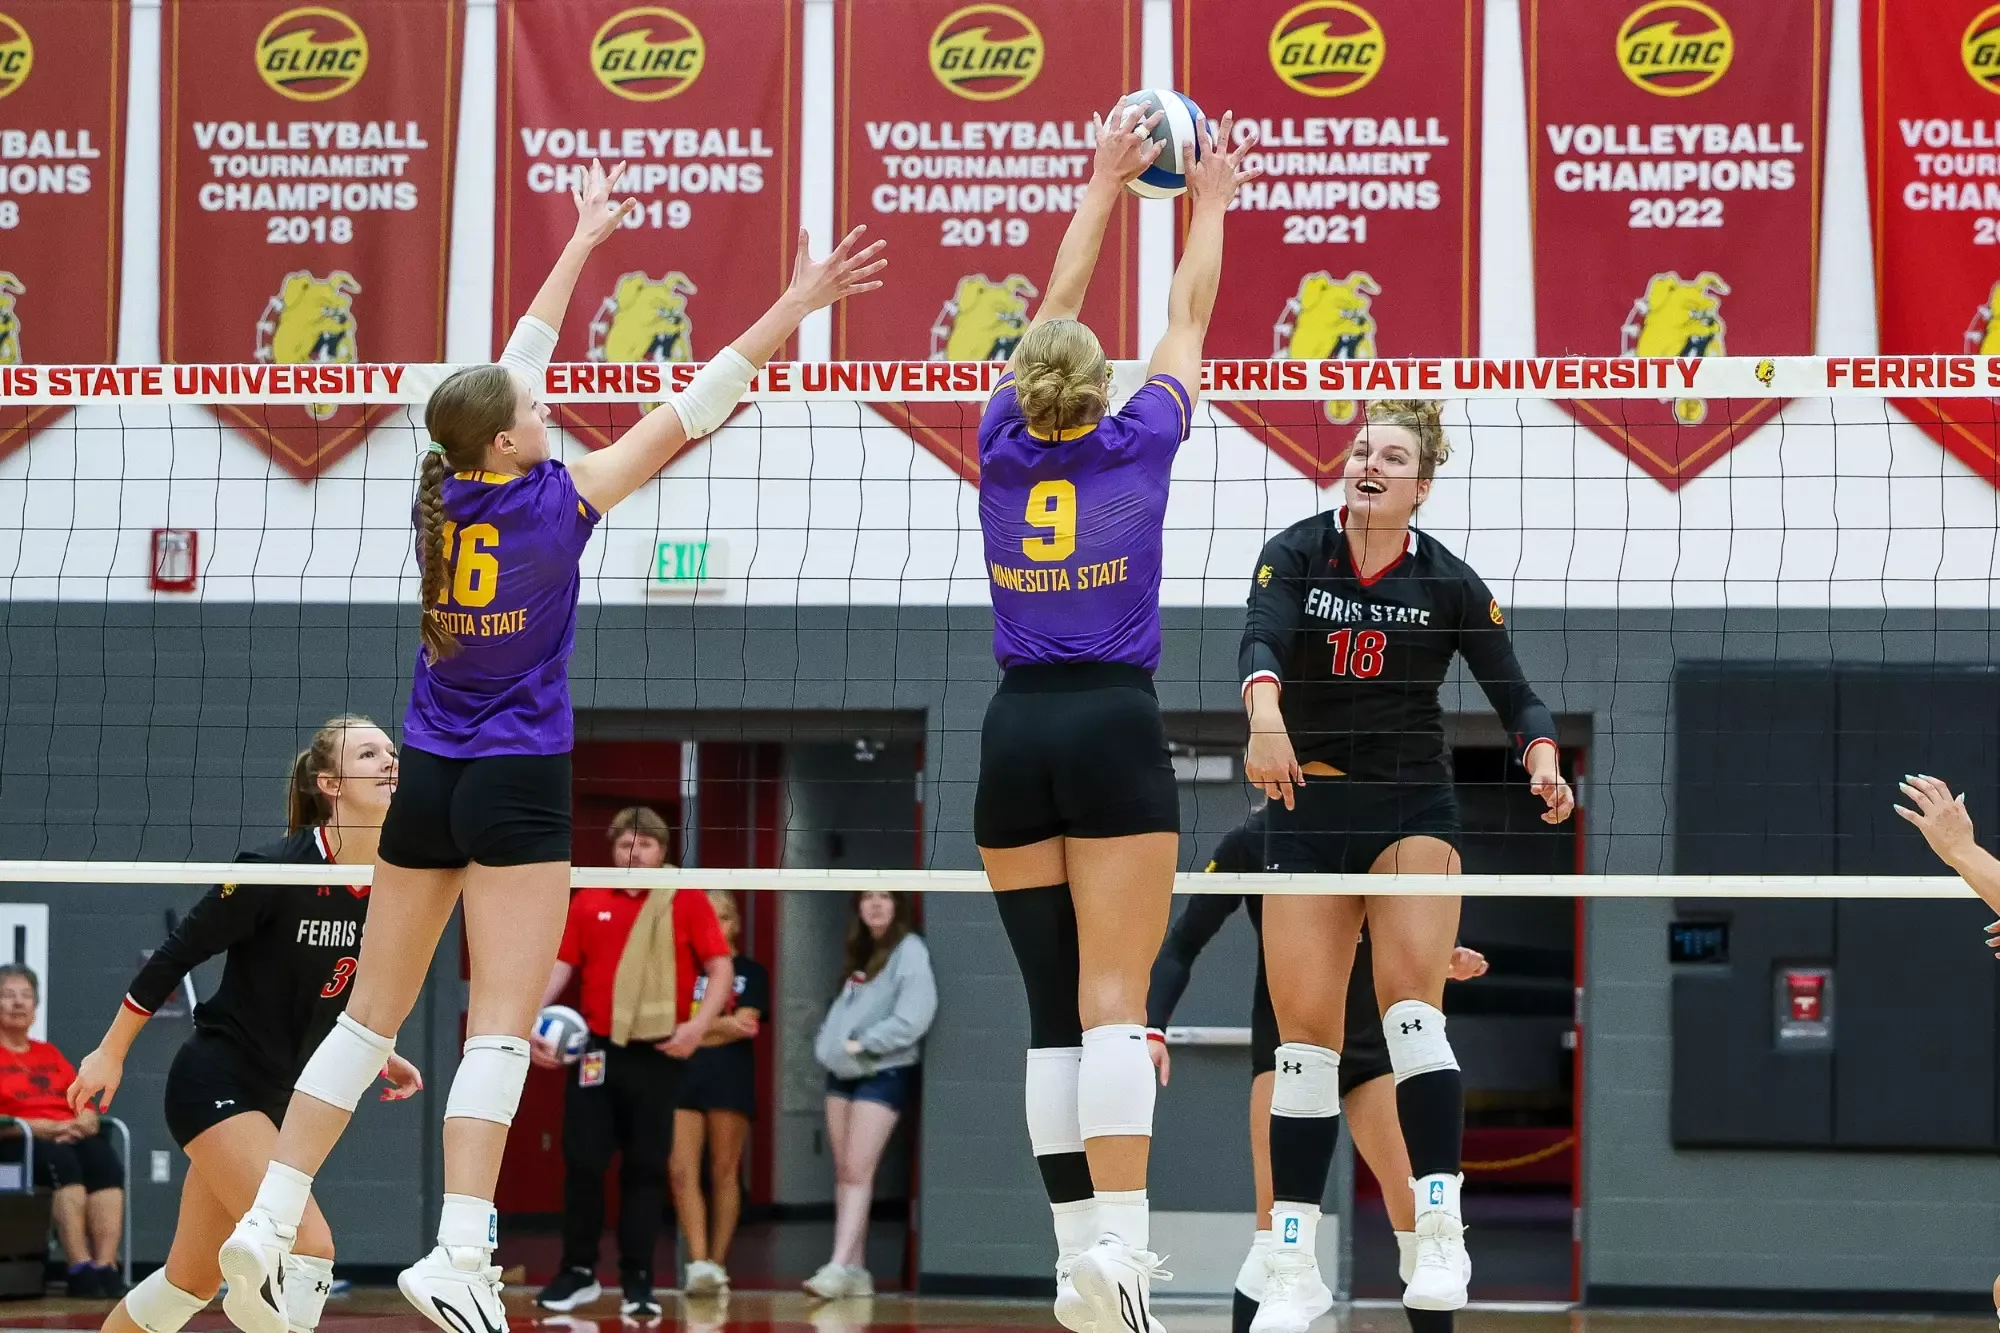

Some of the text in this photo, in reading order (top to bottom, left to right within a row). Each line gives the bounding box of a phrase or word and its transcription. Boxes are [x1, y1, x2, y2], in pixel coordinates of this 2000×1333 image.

[267, 51, 360, 70] GLIAC
[602, 51, 695, 69] GLIAC
[942, 49, 1034, 68] GLIAC
[1282, 44, 1375, 64] GLIAC
[1629, 43, 1723, 64] GLIAC
[194, 121, 428, 149] VOLLEYBALL
[521, 128, 773, 158] VOLLEYBALL
[866, 120, 1097, 150] VOLLEYBALL
[1547, 124, 1803, 154] VOLLEYBALL
[1900, 120, 2000, 147] VOLL
[210, 154, 409, 177] TOURNAMENT
[883, 155, 1088, 179] TOURNAMENT
[1235, 151, 1431, 176] OURNAMENT
[1555, 160, 1794, 191] CHAMPIONS
[1915, 154, 2000, 175] TOUR
[199, 182, 417, 211] CHAMPIONS
[1629, 199, 1723, 228] 2022
[267, 216, 352, 244] 2018
[941, 218, 1029, 246] 2019
[1284, 215, 1366, 243] 2021
[49, 368, 161, 395] STATE
[175, 368, 402, 394] UNIVERSITY
[547, 366, 660, 393] ERRIS
[1201, 360, 1699, 390] ERRIS STATE UNIVERSITY
[1828, 359, 1974, 387] FERRIS
[1024, 480, 1076, 561] 9
[657, 542, 711, 583] EXIT
[989, 555, 1129, 593] MINNESOTA STATE
[480, 608, 528, 637] STATE
[1370, 603, 1431, 627] STATE
[1327, 627, 1387, 679] 18
[296, 919, 357, 947] FERRIS
[320, 956, 358, 998] 3
